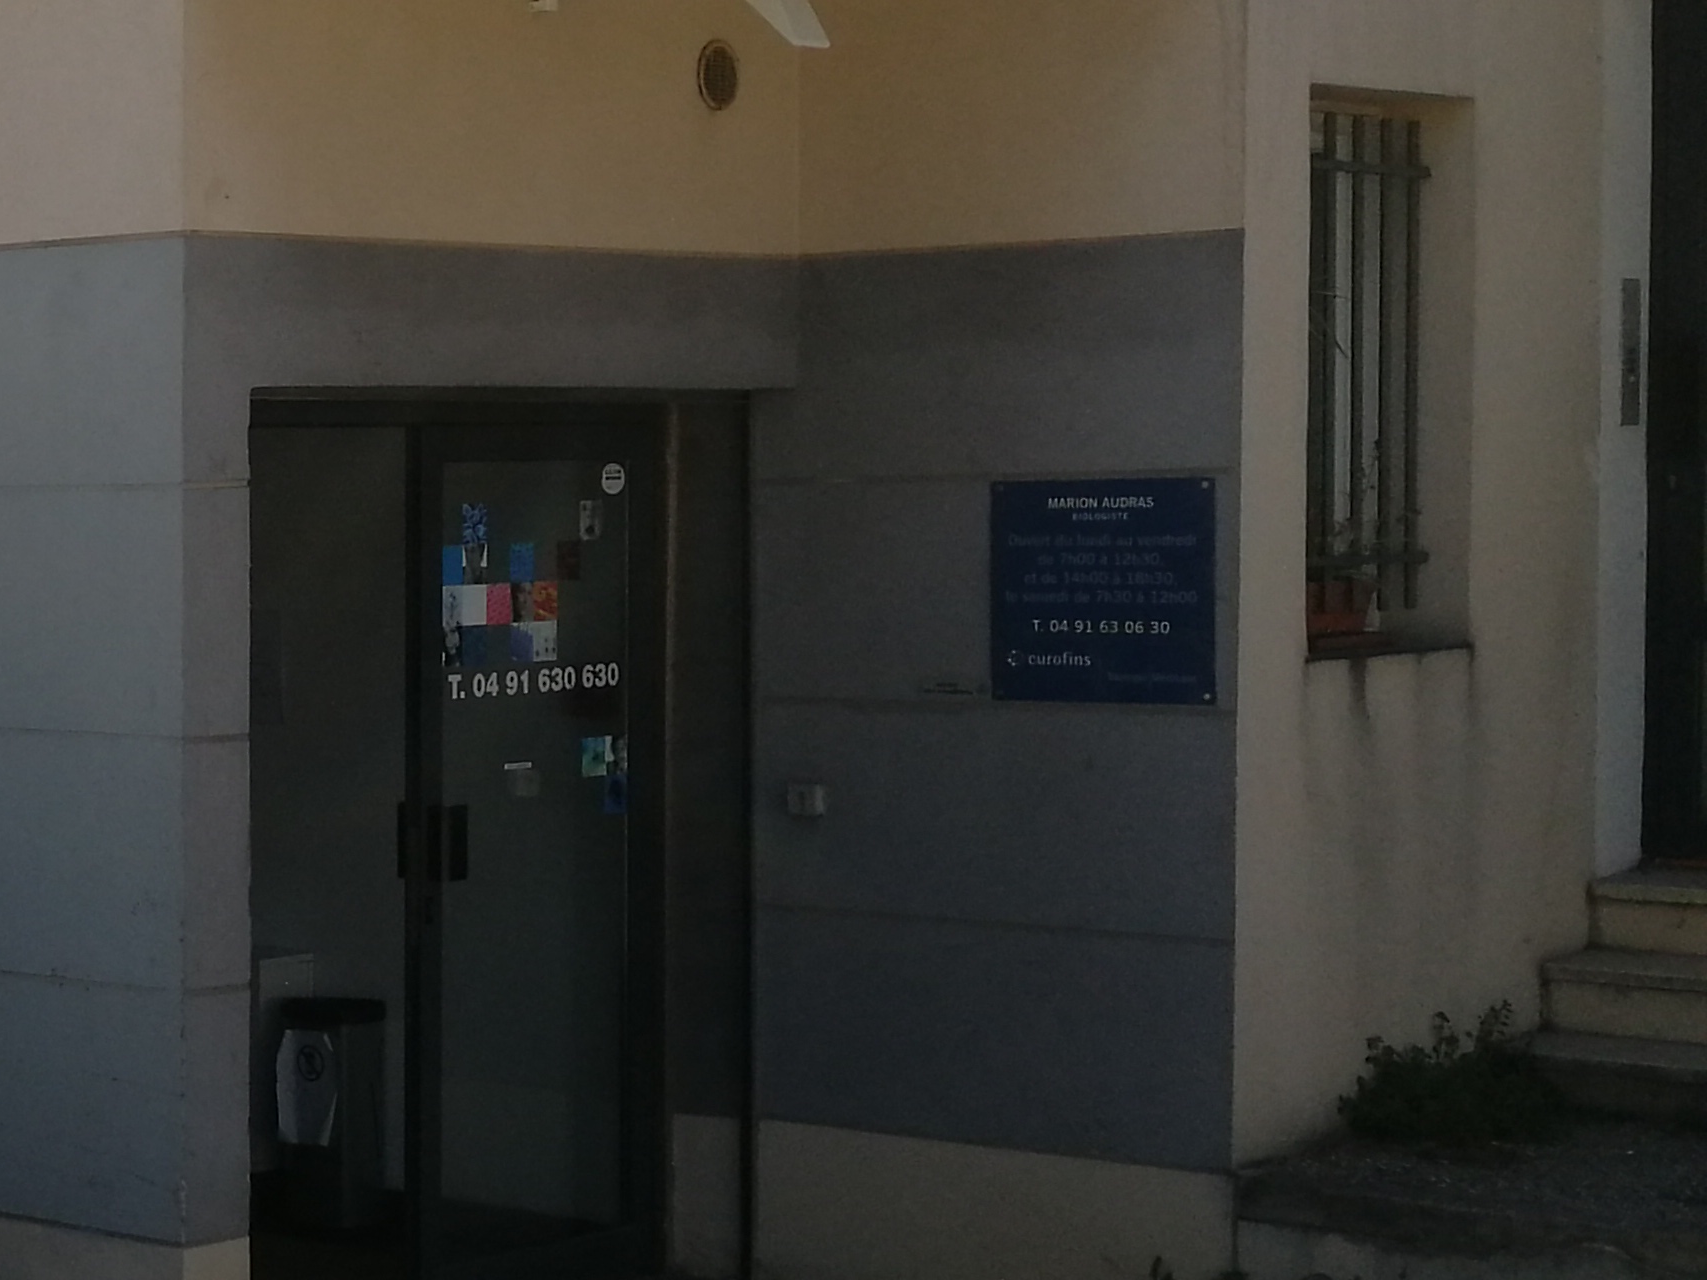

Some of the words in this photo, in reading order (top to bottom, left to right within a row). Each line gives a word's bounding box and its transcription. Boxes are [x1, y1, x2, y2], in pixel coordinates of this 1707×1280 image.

[1048, 497, 1098, 509] MARION
[1101, 496, 1155, 509] AUDRAS
[1076, 533, 1111, 547] lundi
[1137, 533, 1197, 547] vendredi
[1060, 552, 1095, 566] 7h00
[1022, 590, 1069, 604] samedi
[1095, 589, 1132, 603] 7h30
[1151, 590, 1198, 604] 12h00
[1049, 619, 1069, 633] 04
[1074, 619, 1093, 634] 91
[1099, 619, 1119, 634] 63
[1125, 620, 1144, 634] 06
[1150, 620, 1171, 634] 30
[1028, 650, 1091, 667] eurofins
[447, 673, 466, 700] T.
[472, 671, 500, 698] 04
[505, 669, 530, 696] 91
[537, 665, 577, 693] 630
[581, 662, 620, 689] 630
